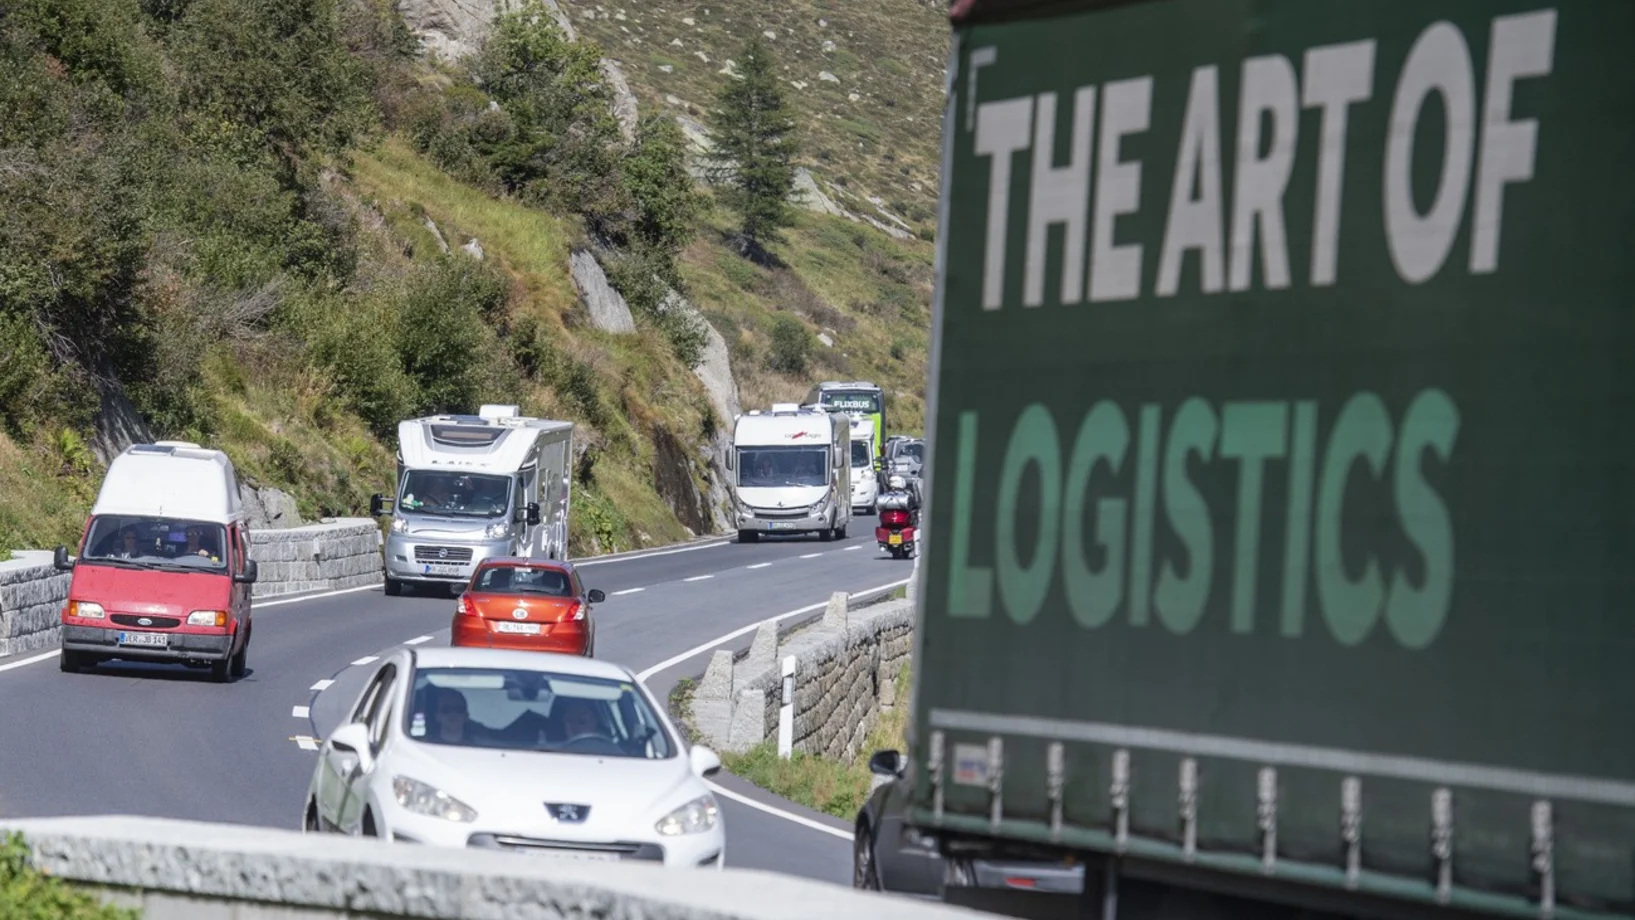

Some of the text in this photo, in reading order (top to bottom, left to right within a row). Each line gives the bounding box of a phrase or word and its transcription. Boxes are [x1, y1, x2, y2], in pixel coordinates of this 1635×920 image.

[974, 8, 1558, 311] THE ART OF
[833, 400, 870, 409] FLIXBUS
[946, 388, 1461, 650] LOGISTICS
